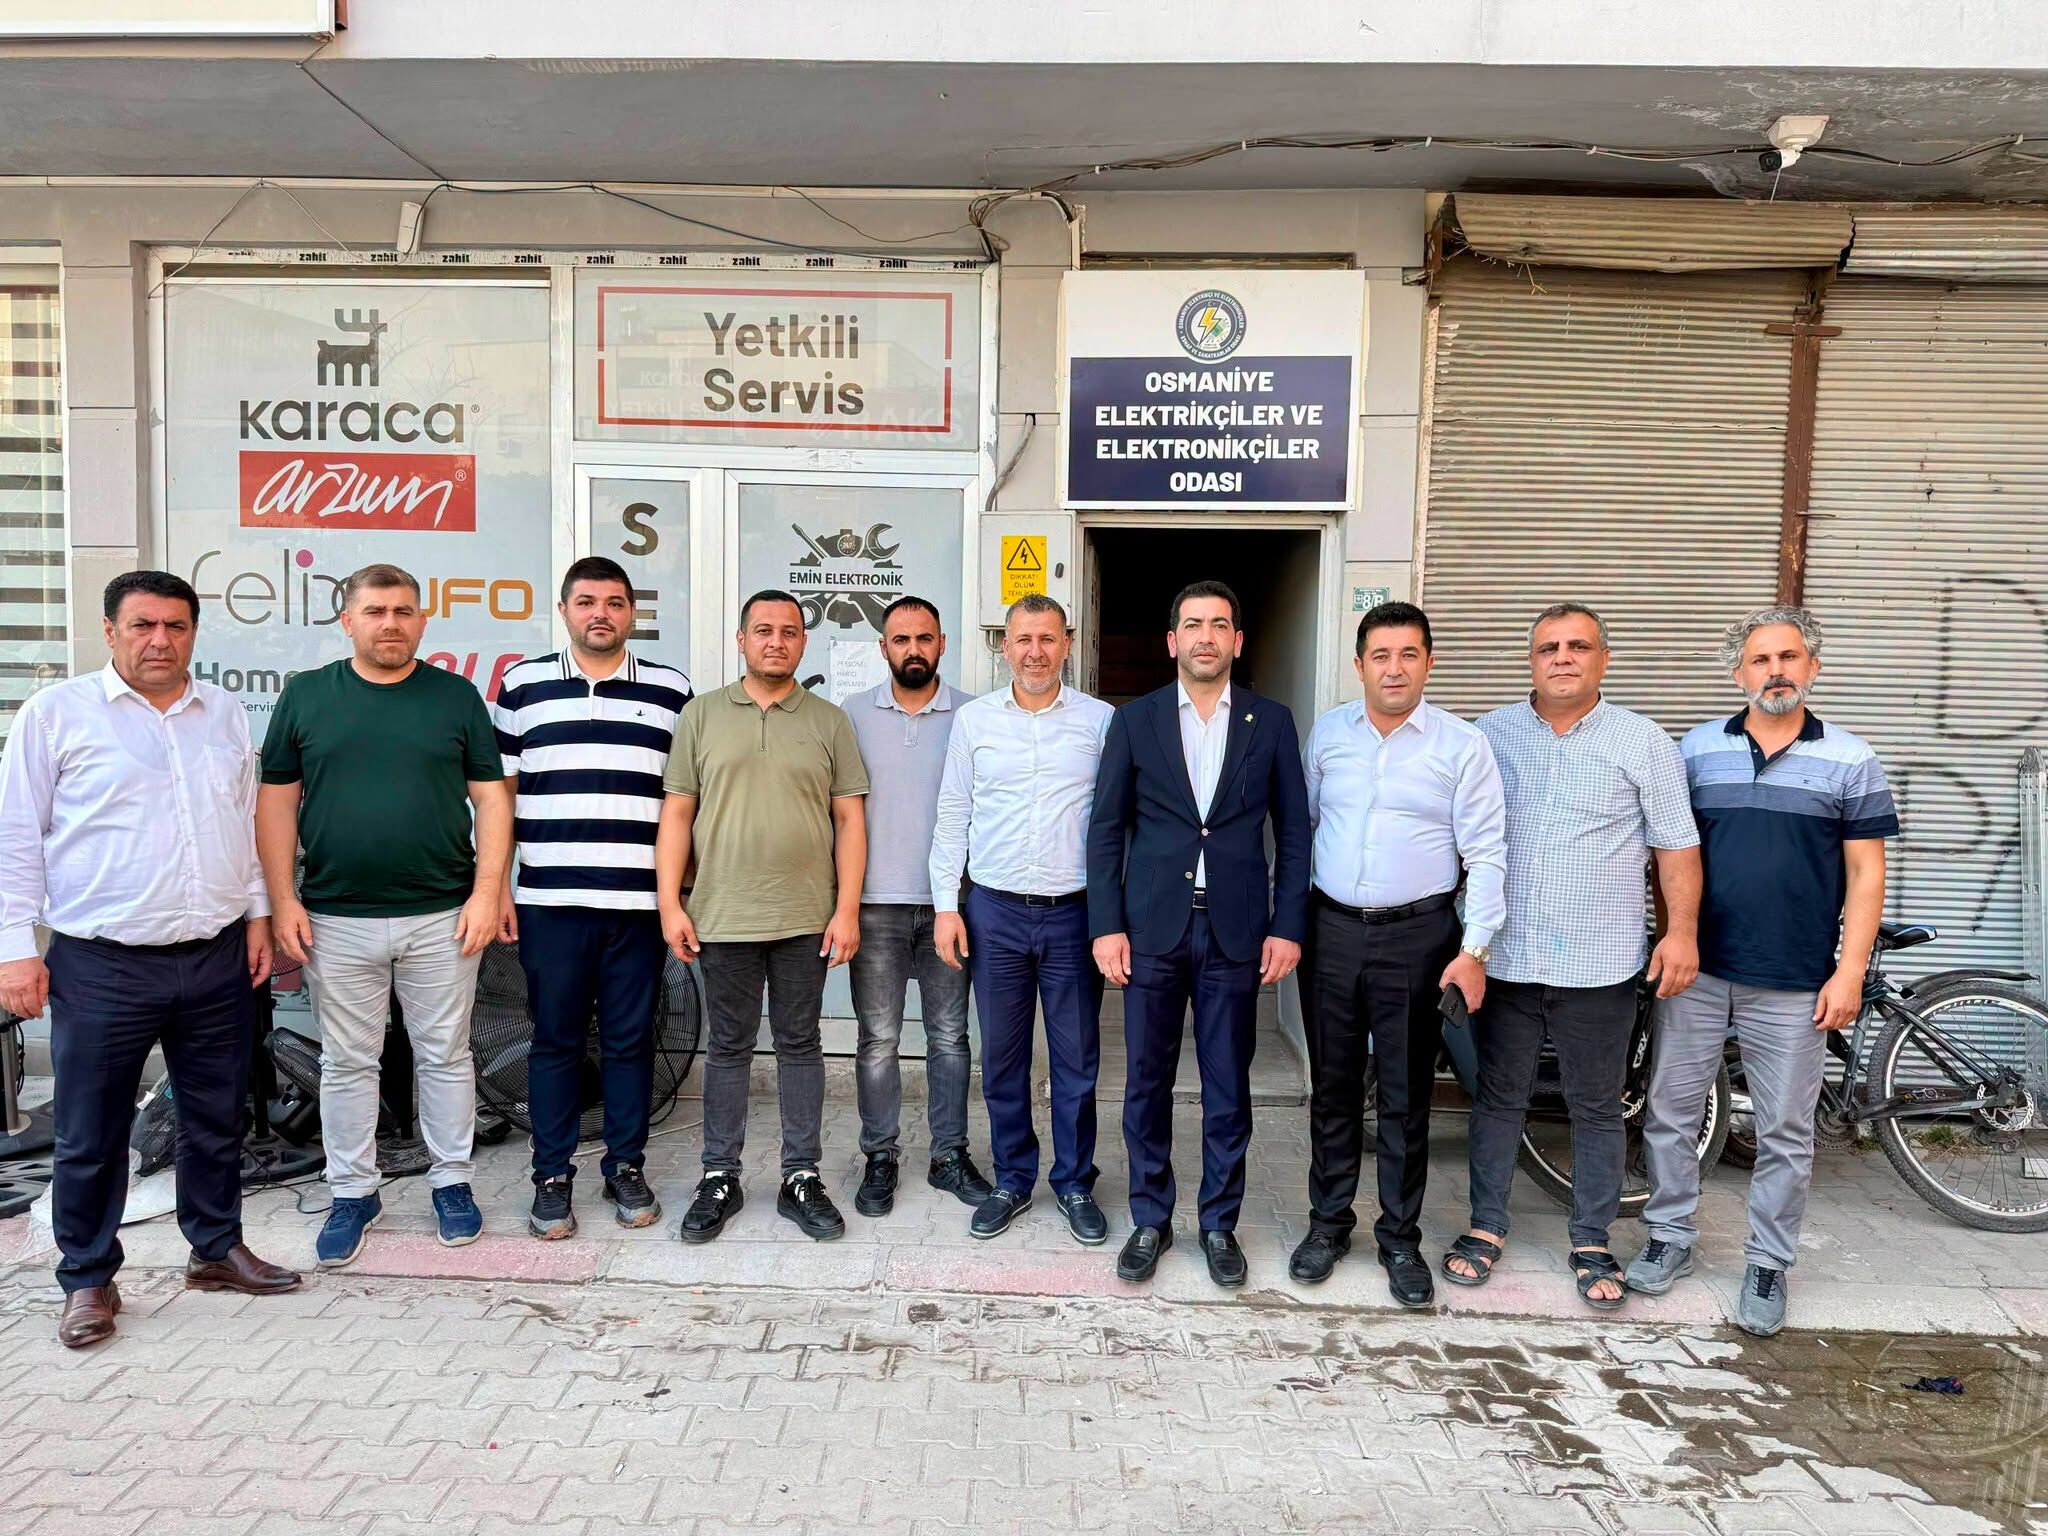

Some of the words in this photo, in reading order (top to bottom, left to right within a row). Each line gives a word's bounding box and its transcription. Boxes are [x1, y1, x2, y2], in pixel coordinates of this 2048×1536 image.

[704, 312, 859, 359] Yetkili
[704, 368, 864, 415] Servis
[1145, 366, 1275, 393] OSMANİYE
[1096, 400, 1285, 430] ELEKTRİKÇİLER
[1290, 405, 1324, 426] VE
[1096, 433, 1320, 464] ELEKTRONİKÇİLER
[1170, 471, 1243, 493] ODASI
[789, 569, 822, 584] EMİN
[825, 571, 904, 586] ELEKTRONİK
